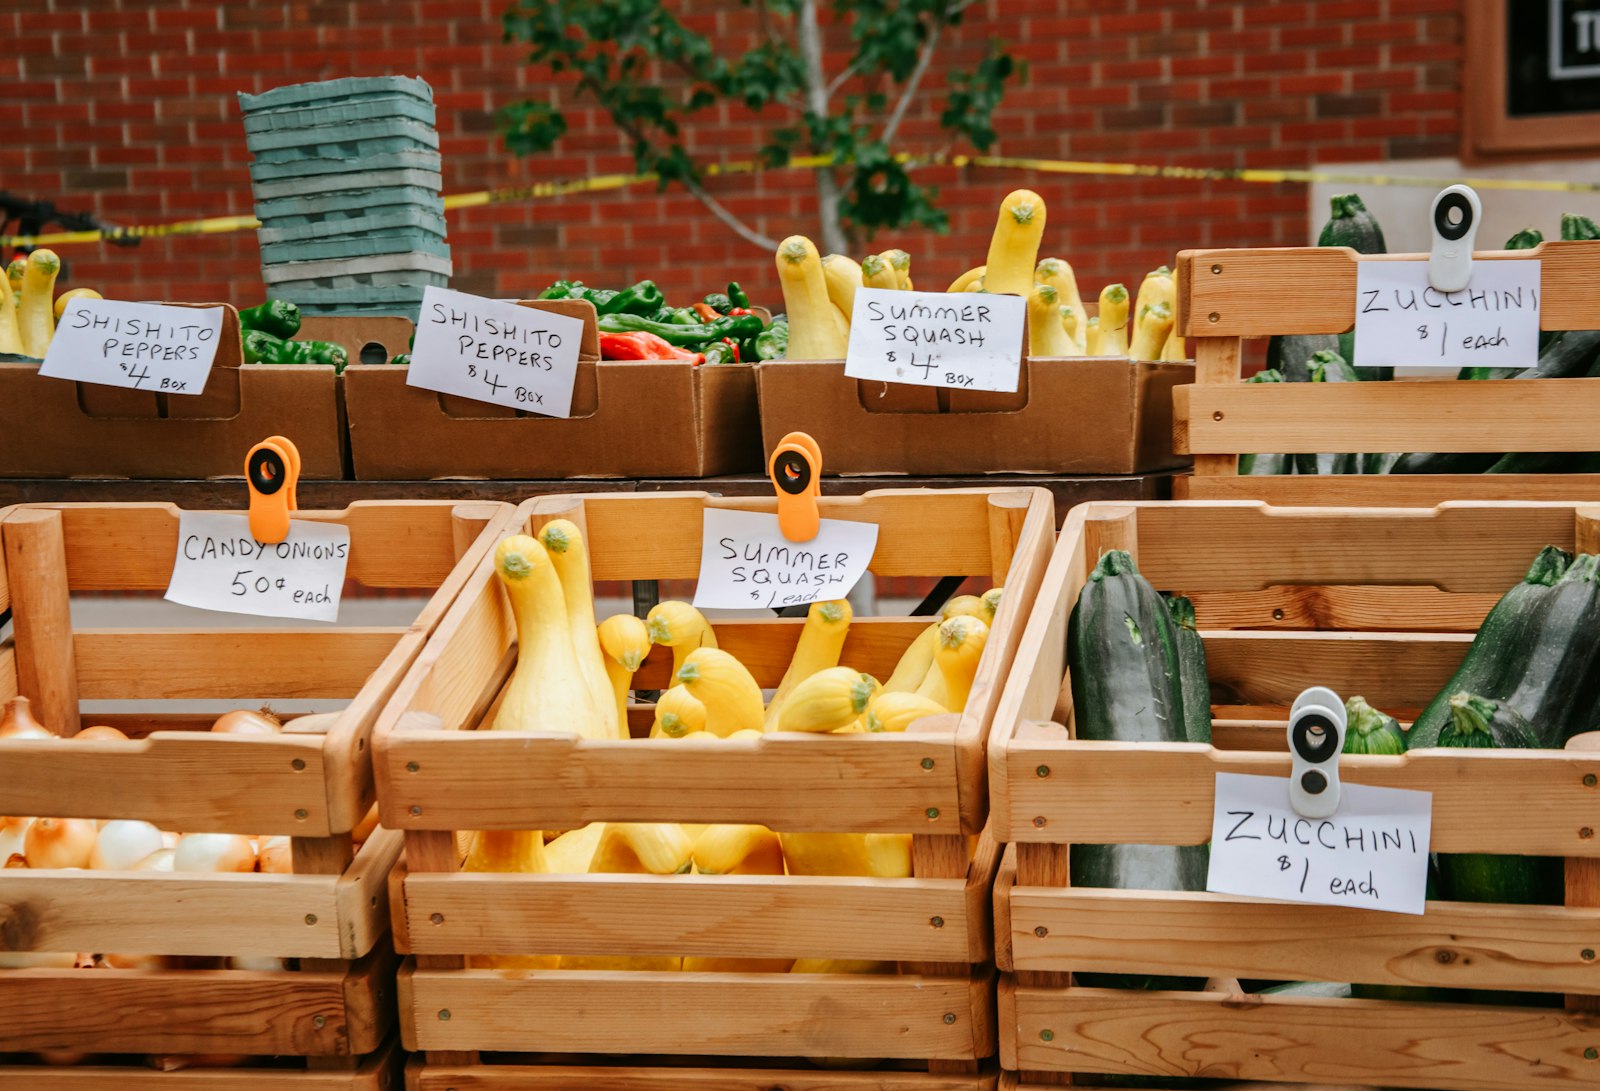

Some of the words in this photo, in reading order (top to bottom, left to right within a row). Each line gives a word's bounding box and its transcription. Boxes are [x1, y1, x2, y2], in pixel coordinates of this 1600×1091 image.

[867, 301, 992, 323] SUMMER
[1362, 286, 1537, 314] ZUCCHINI
[71, 309, 214, 341] SHISHITO
[431, 303, 562, 349] SHISHITO
[883, 325, 985, 348] SQUASH
[1416, 322, 1448, 357] $1
[102, 338, 200, 361] PEPPERS
[458, 335, 553, 371] PEPPERS
[119, 362, 150, 389] $4
[184, 535, 266, 560] CANDY
[276, 542, 348, 560] ONIONS
[719, 537, 849, 571] SUMMER
[731, 566, 845, 587] SQUASH
[1224, 810, 1417, 854] ZUCCHINI
[1277, 855, 1310, 894] $1
